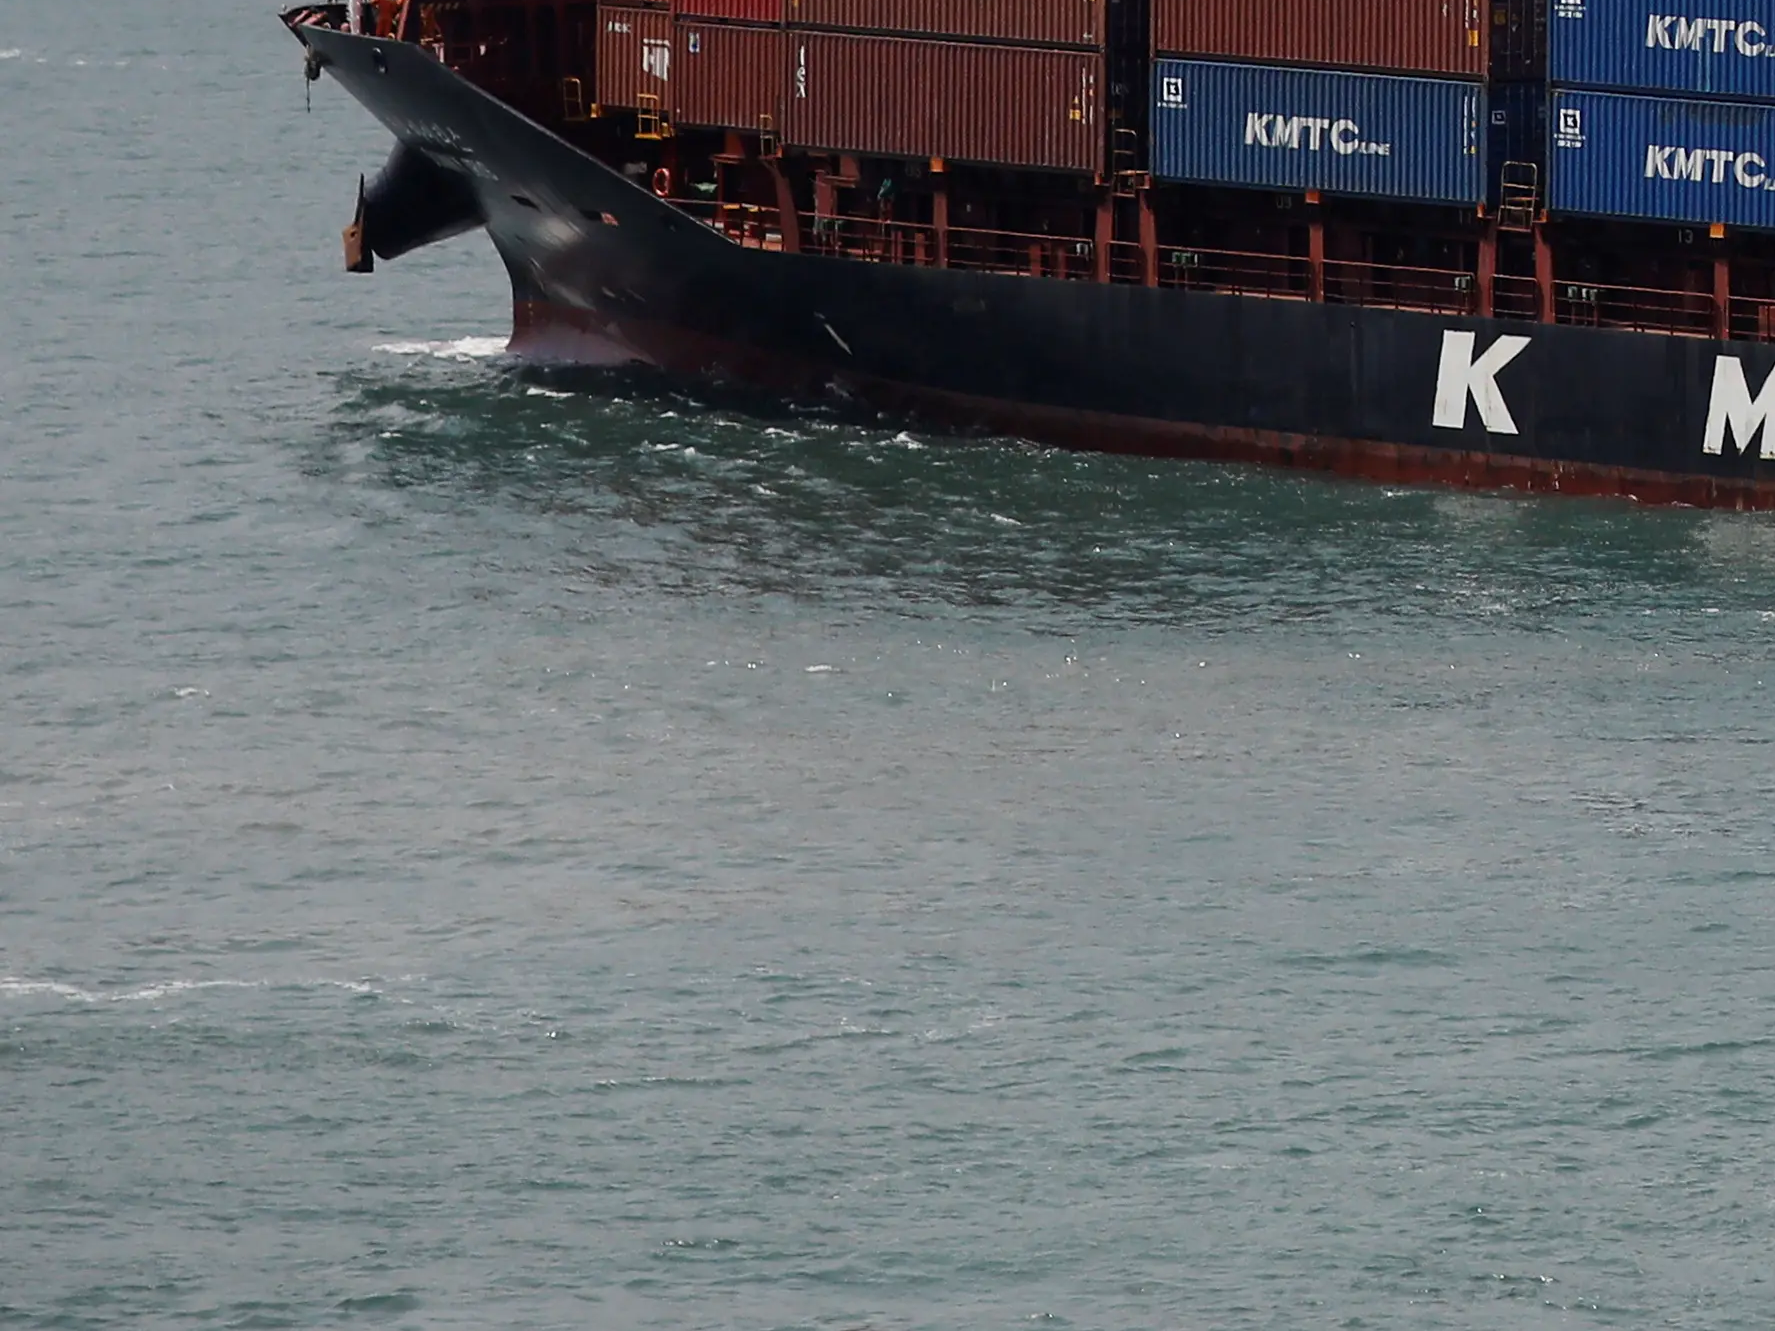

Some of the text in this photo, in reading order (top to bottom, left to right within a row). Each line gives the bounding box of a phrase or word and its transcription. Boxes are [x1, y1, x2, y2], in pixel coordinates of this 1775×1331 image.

[1647, 14, 1766, 58] KMTC
[1245, 112, 1390, 156] KMTC LINE
[1645, 144, 1765, 188] KMTC
[1678, 229, 1693, 244] 13
[1432, 330, 1532, 435] K
